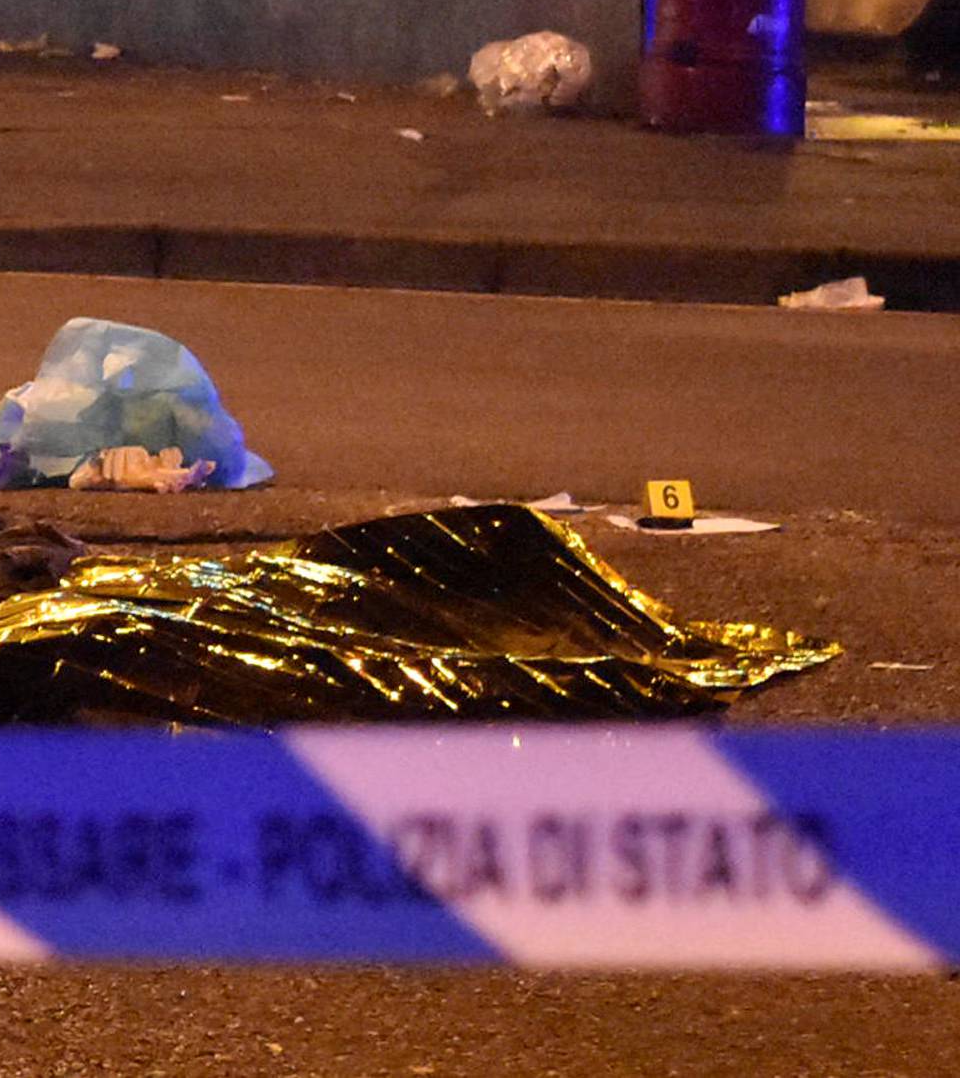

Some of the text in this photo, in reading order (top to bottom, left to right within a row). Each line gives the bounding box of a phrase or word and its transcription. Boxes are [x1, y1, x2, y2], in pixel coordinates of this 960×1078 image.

[662, 484, 680, 510] 6
[256, 810, 504, 904] POLIZIA
[529, 812, 589, 904] DI
[616, 810, 830, 904] STATO
